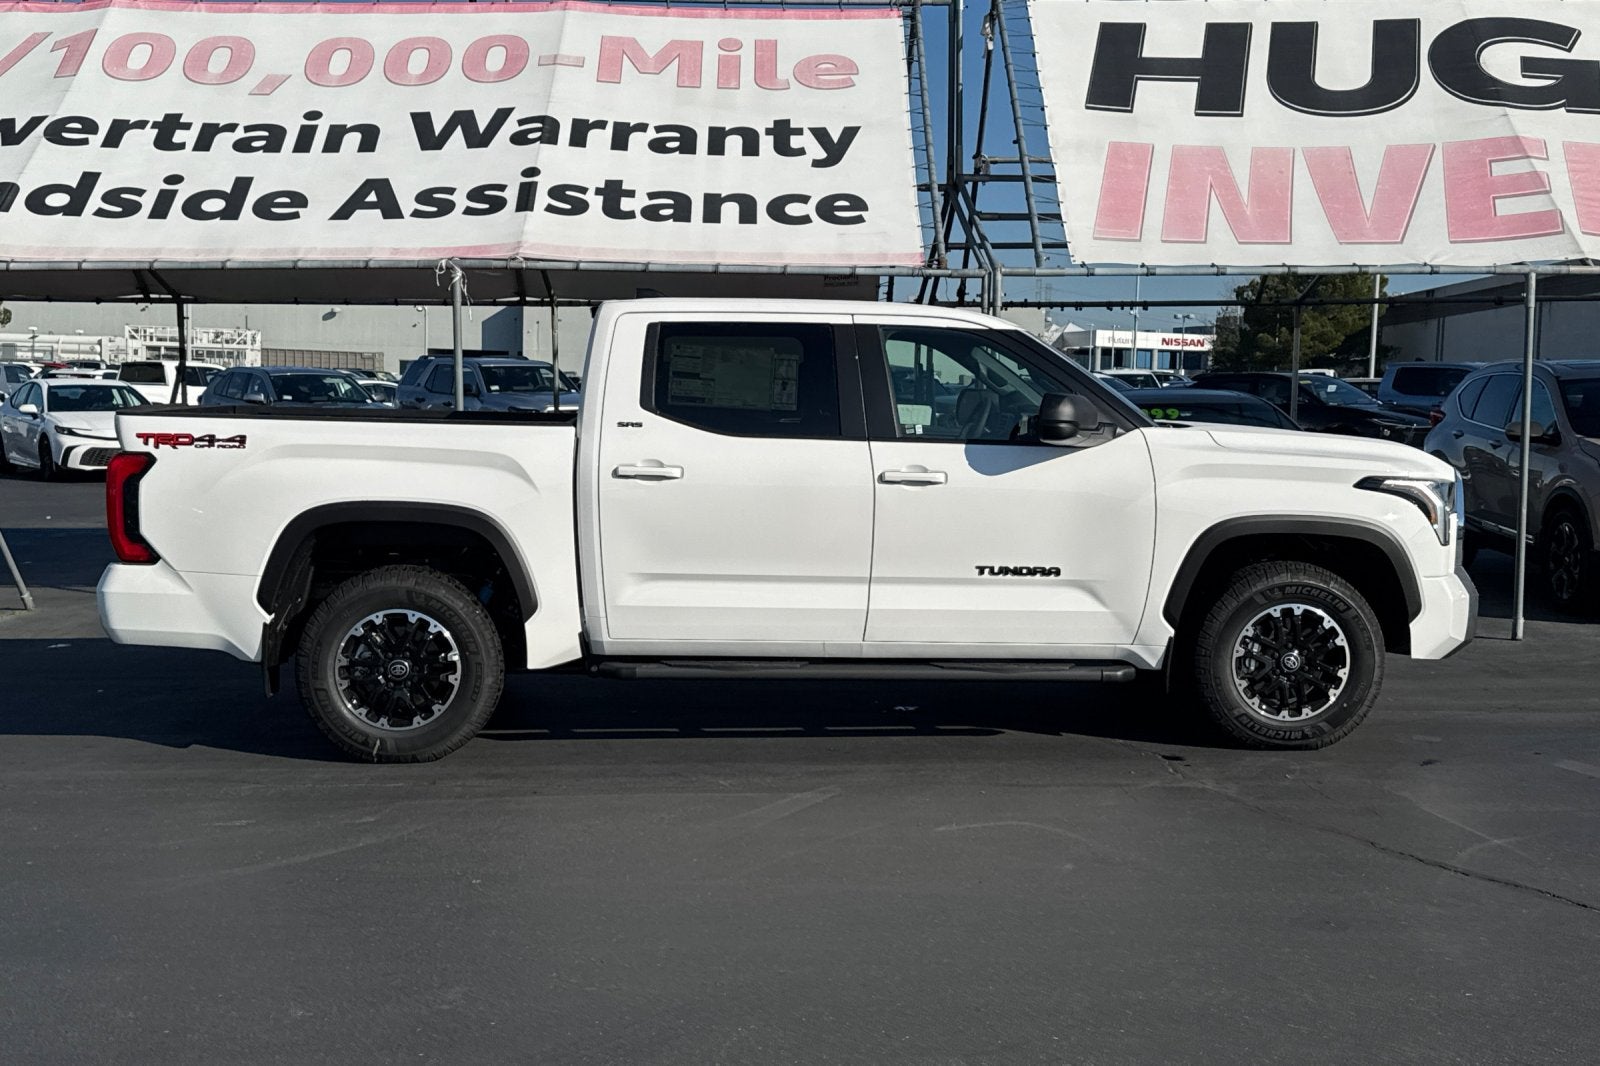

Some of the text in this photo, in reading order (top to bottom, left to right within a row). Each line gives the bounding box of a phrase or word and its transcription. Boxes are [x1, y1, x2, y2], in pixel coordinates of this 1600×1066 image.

[410, 107, 862, 169] Warranty
[328, 166, 869, 226] Assistance
[1161, 337, 1205, 348] NISSAN
[975, 565, 1062, 577] TUNDRA
[1283, 584, 1350, 613] MICHELIN
